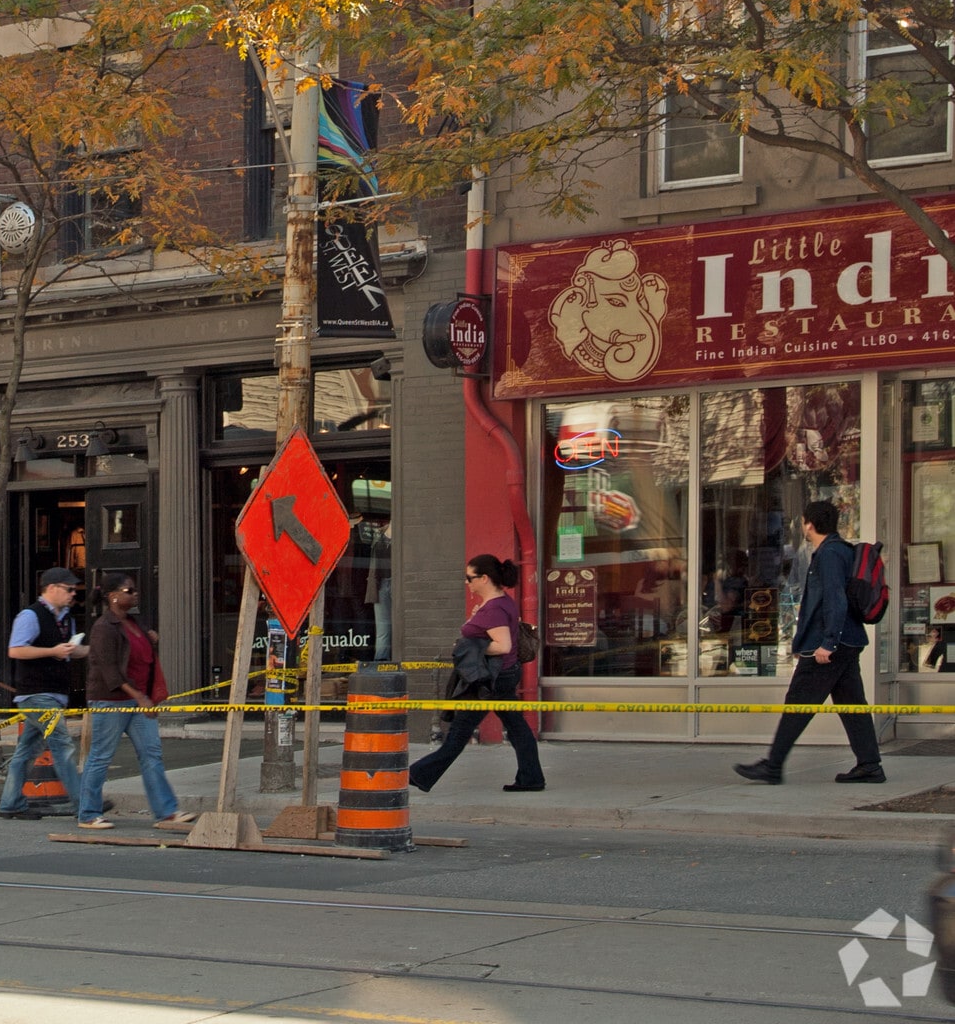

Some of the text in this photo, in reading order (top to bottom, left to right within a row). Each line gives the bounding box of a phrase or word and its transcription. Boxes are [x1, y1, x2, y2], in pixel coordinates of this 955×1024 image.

[748, 231, 843, 265] Little
[328, 251, 358, 291] WEST
[450, 322, 485, 343] India
[695, 348, 725, 361] Fine
[732, 345, 777, 359] Indian
[784, 339, 838, 353] Cuisine
[862, 334, 897, 347] LLBO
[56, 433, 90, 448] 253
[554, 436, 620, 463] OPEN
[555, 586, 586, 594] India
[735, 647, 758, 656] where
